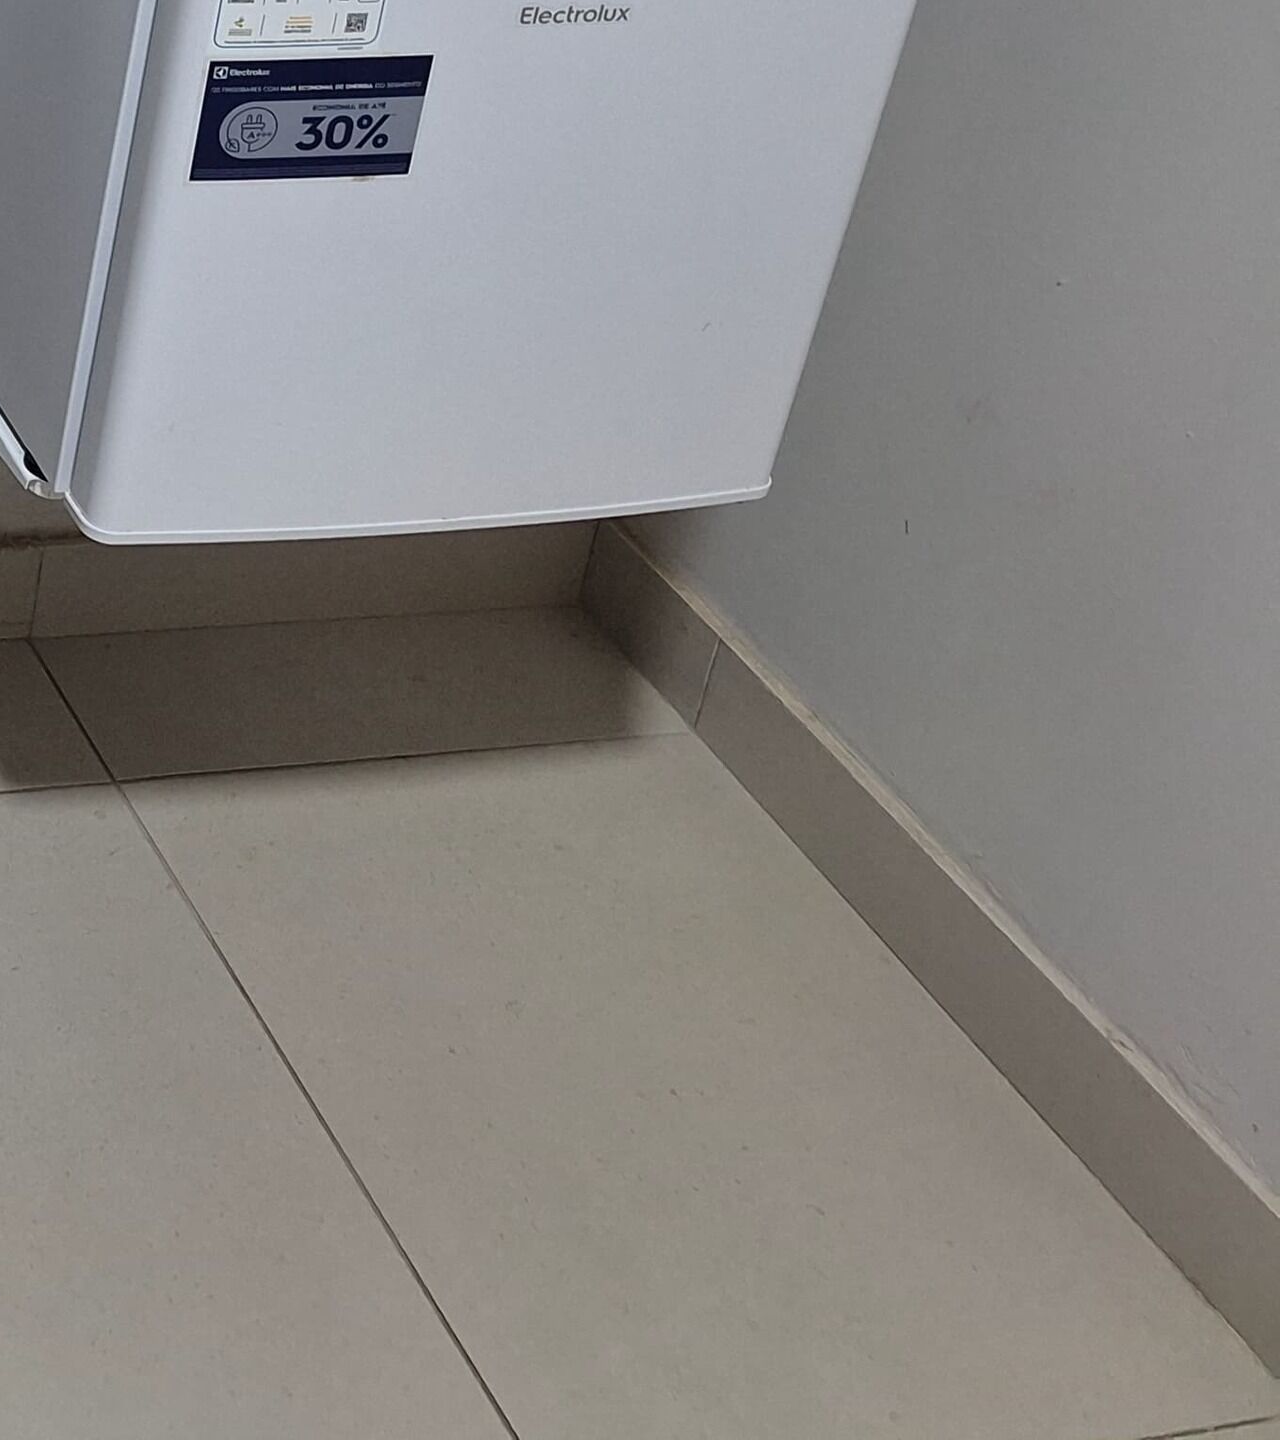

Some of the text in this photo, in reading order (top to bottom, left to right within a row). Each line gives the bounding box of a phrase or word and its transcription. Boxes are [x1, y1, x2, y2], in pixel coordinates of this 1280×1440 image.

[520, 4, 631, 25] Electrolux
[229, 68, 271, 77] Electrolux
[294, 113, 391, 152] 30%
